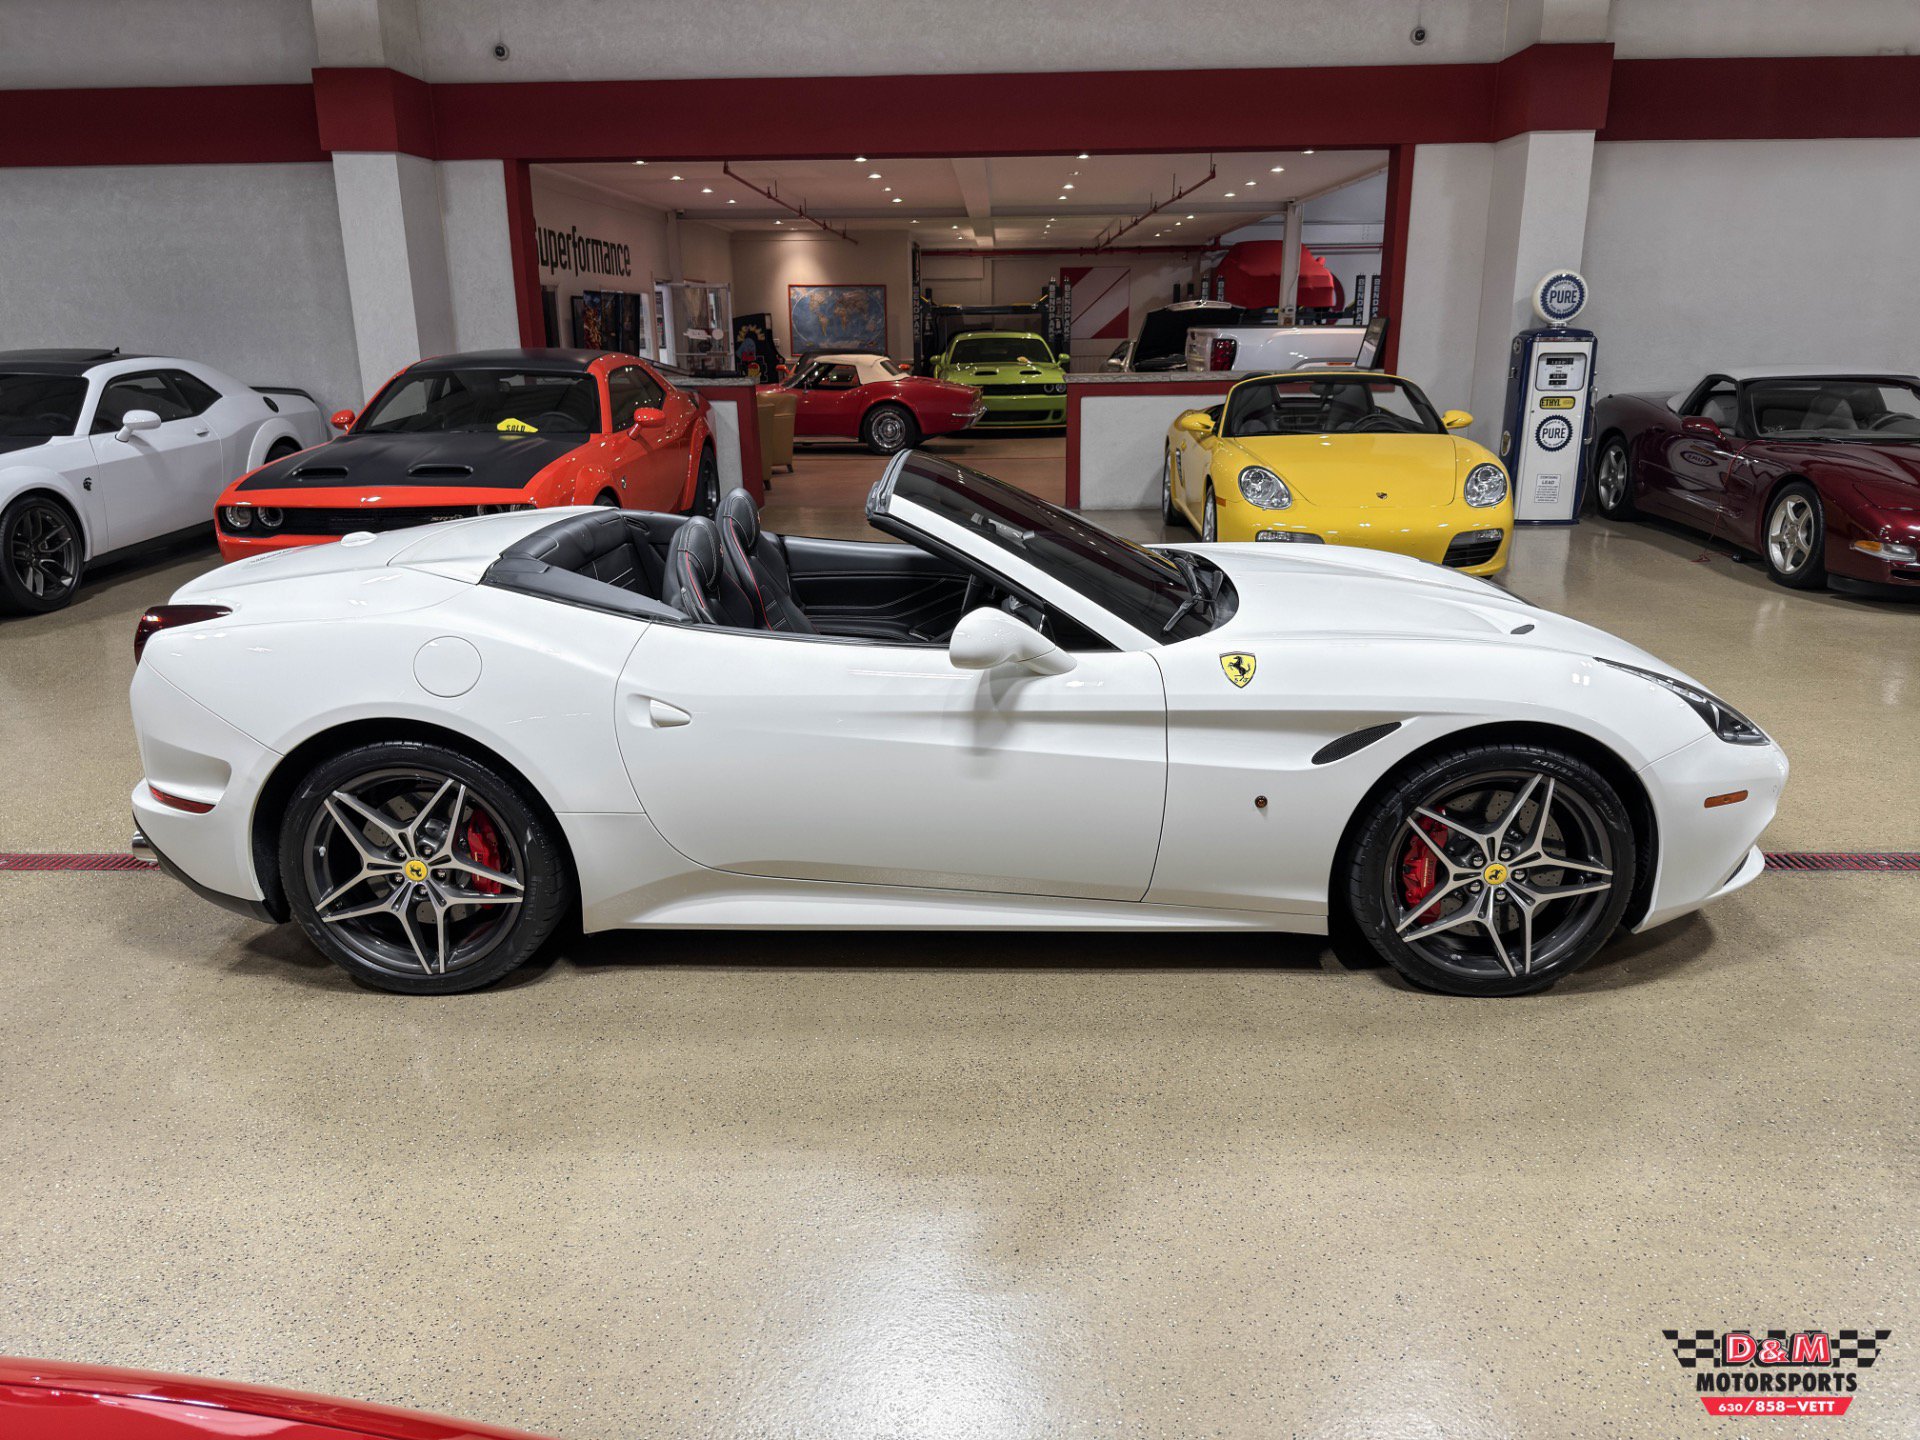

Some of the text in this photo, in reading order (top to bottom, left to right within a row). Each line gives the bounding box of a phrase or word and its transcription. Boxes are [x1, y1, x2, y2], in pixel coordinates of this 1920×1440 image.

[534, 224, 632, 278] uperformance
[1549, 289, 1577, 305] PURE
[1541, 398, 1561, 407] ETHYL
[506, 424, 526, 432] SOLD
[1541, 426, 1566, 439] PURE
